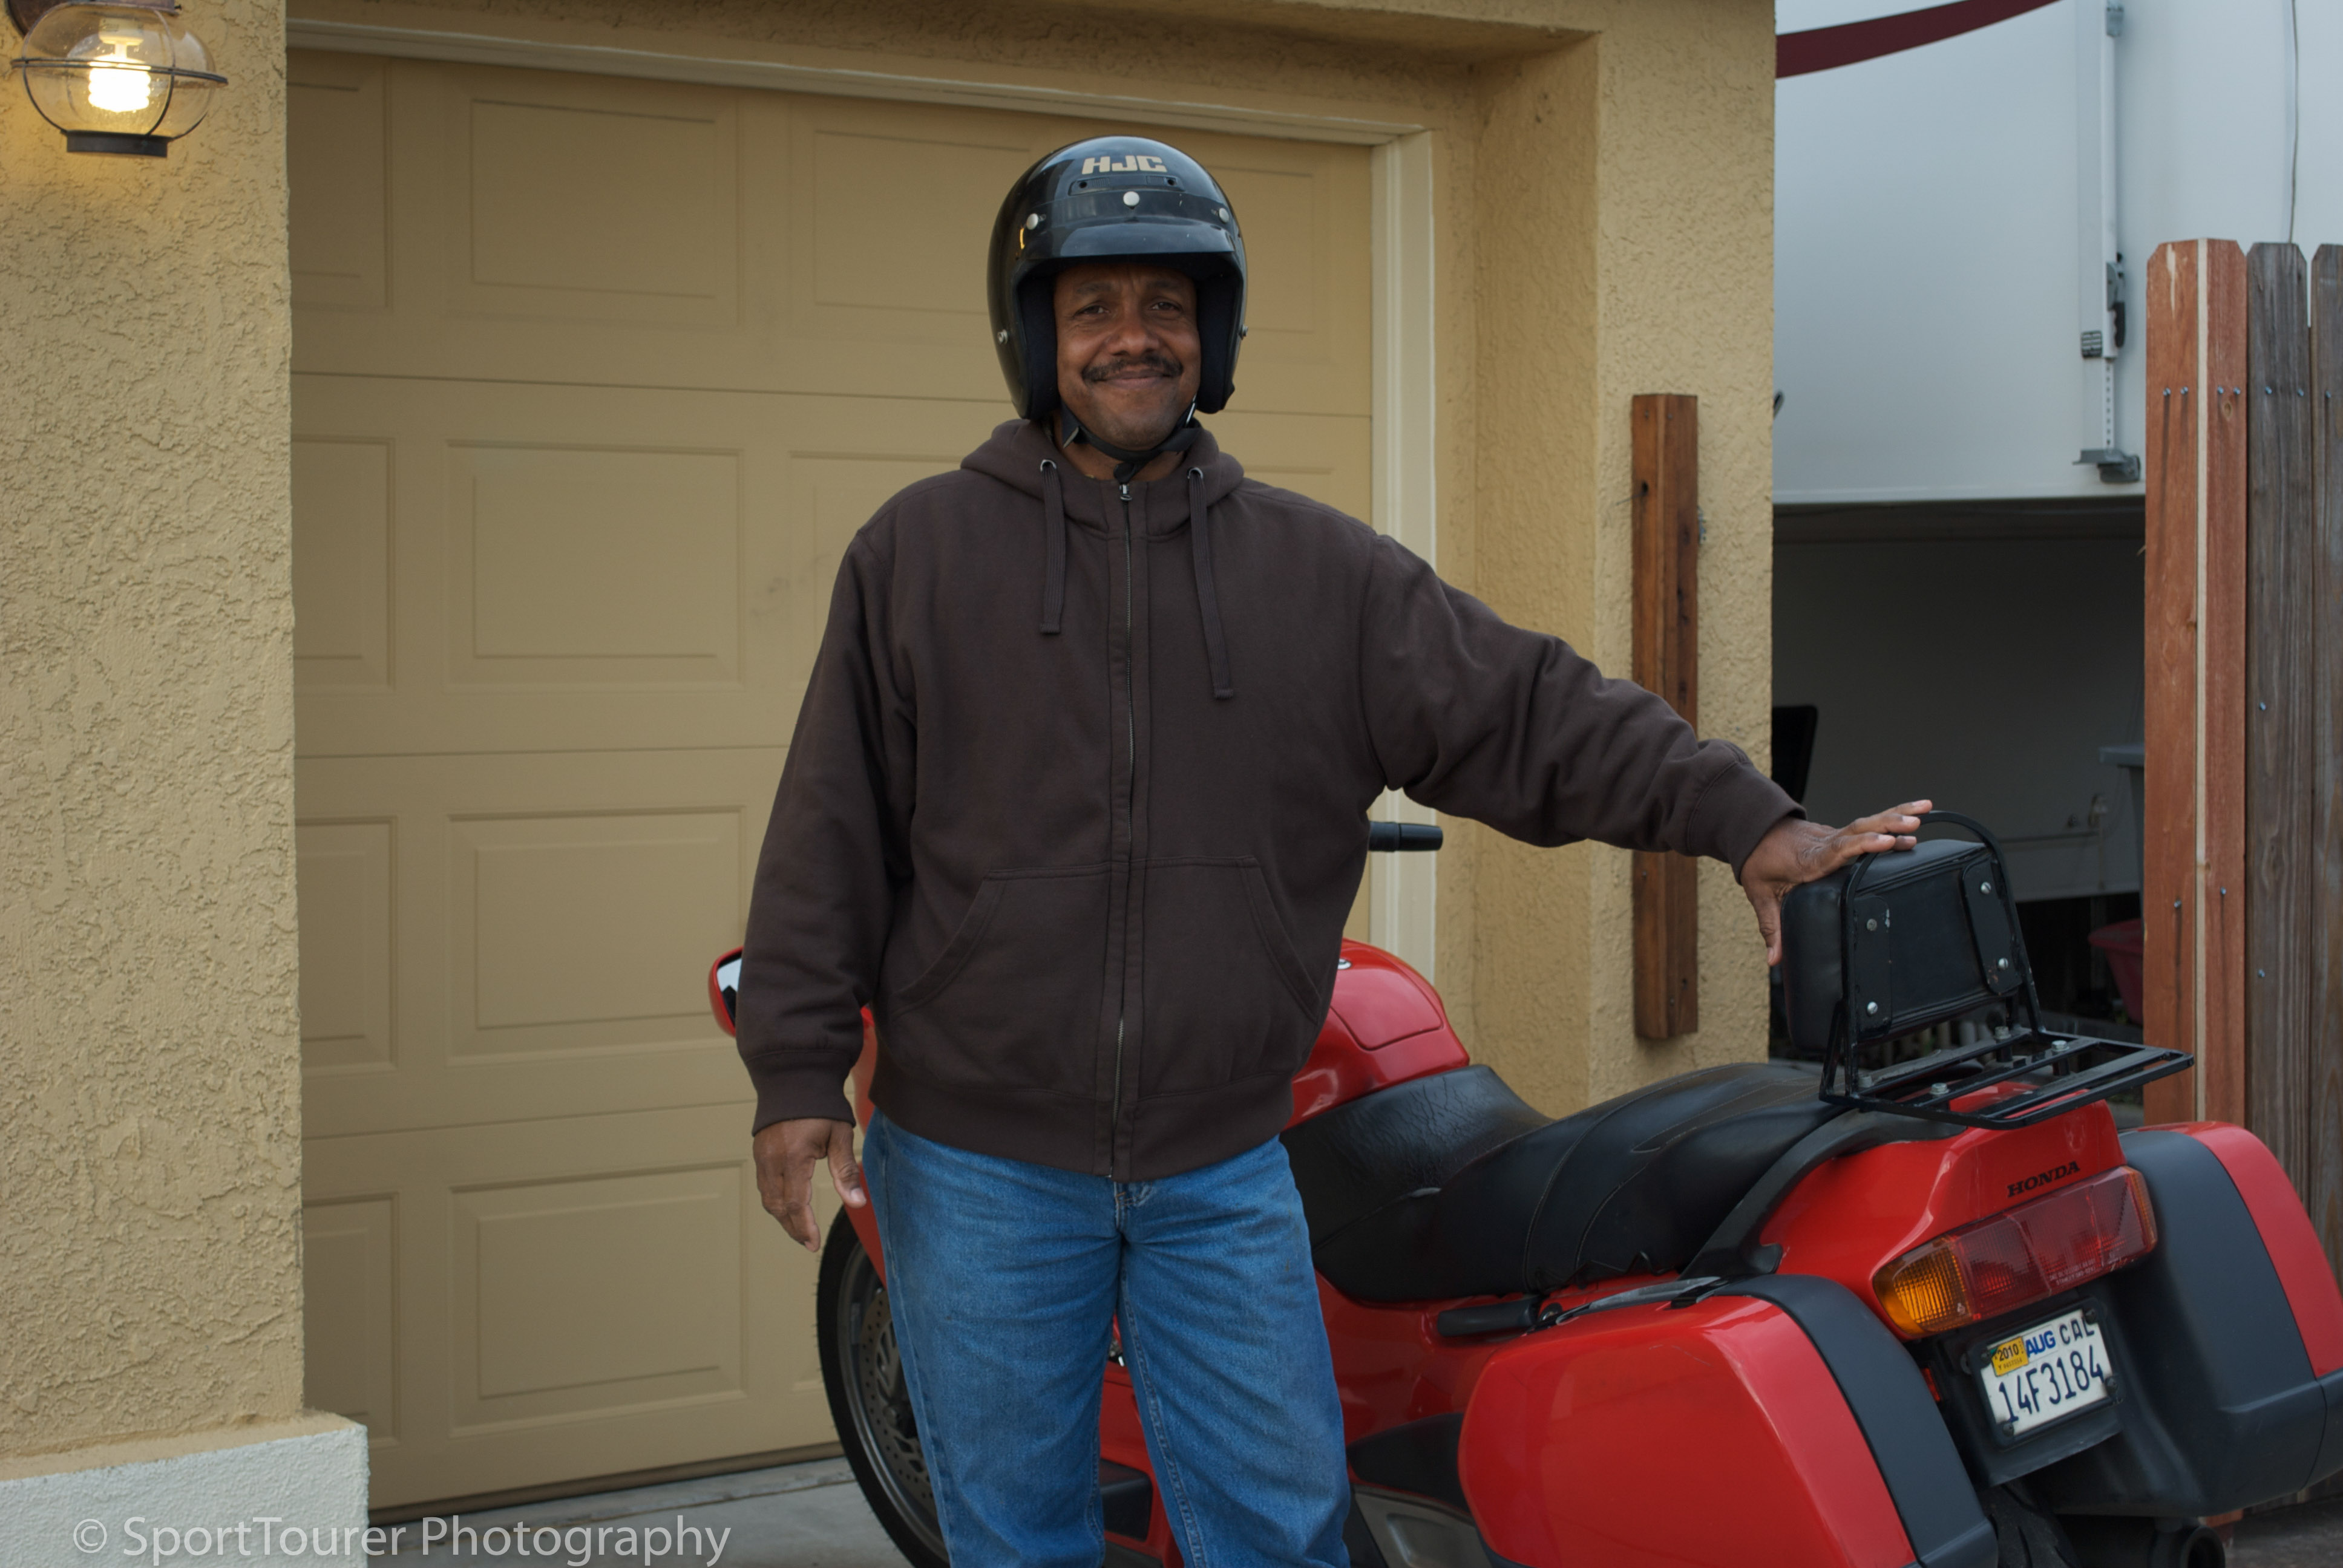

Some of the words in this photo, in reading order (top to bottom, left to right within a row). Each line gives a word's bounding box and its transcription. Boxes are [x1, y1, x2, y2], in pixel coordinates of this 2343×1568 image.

[1081, 155, 1167, 175] HJC
[2007, 1161, 2080, 1198] HONDA
[2025, 1330, 2056, 1358] AUG
[2059, 1316, 2095, 1345] CAL
[1997, 1344, 2019, 1362] 2010
[1999, 1345, 2105, 1422] 14F3184
